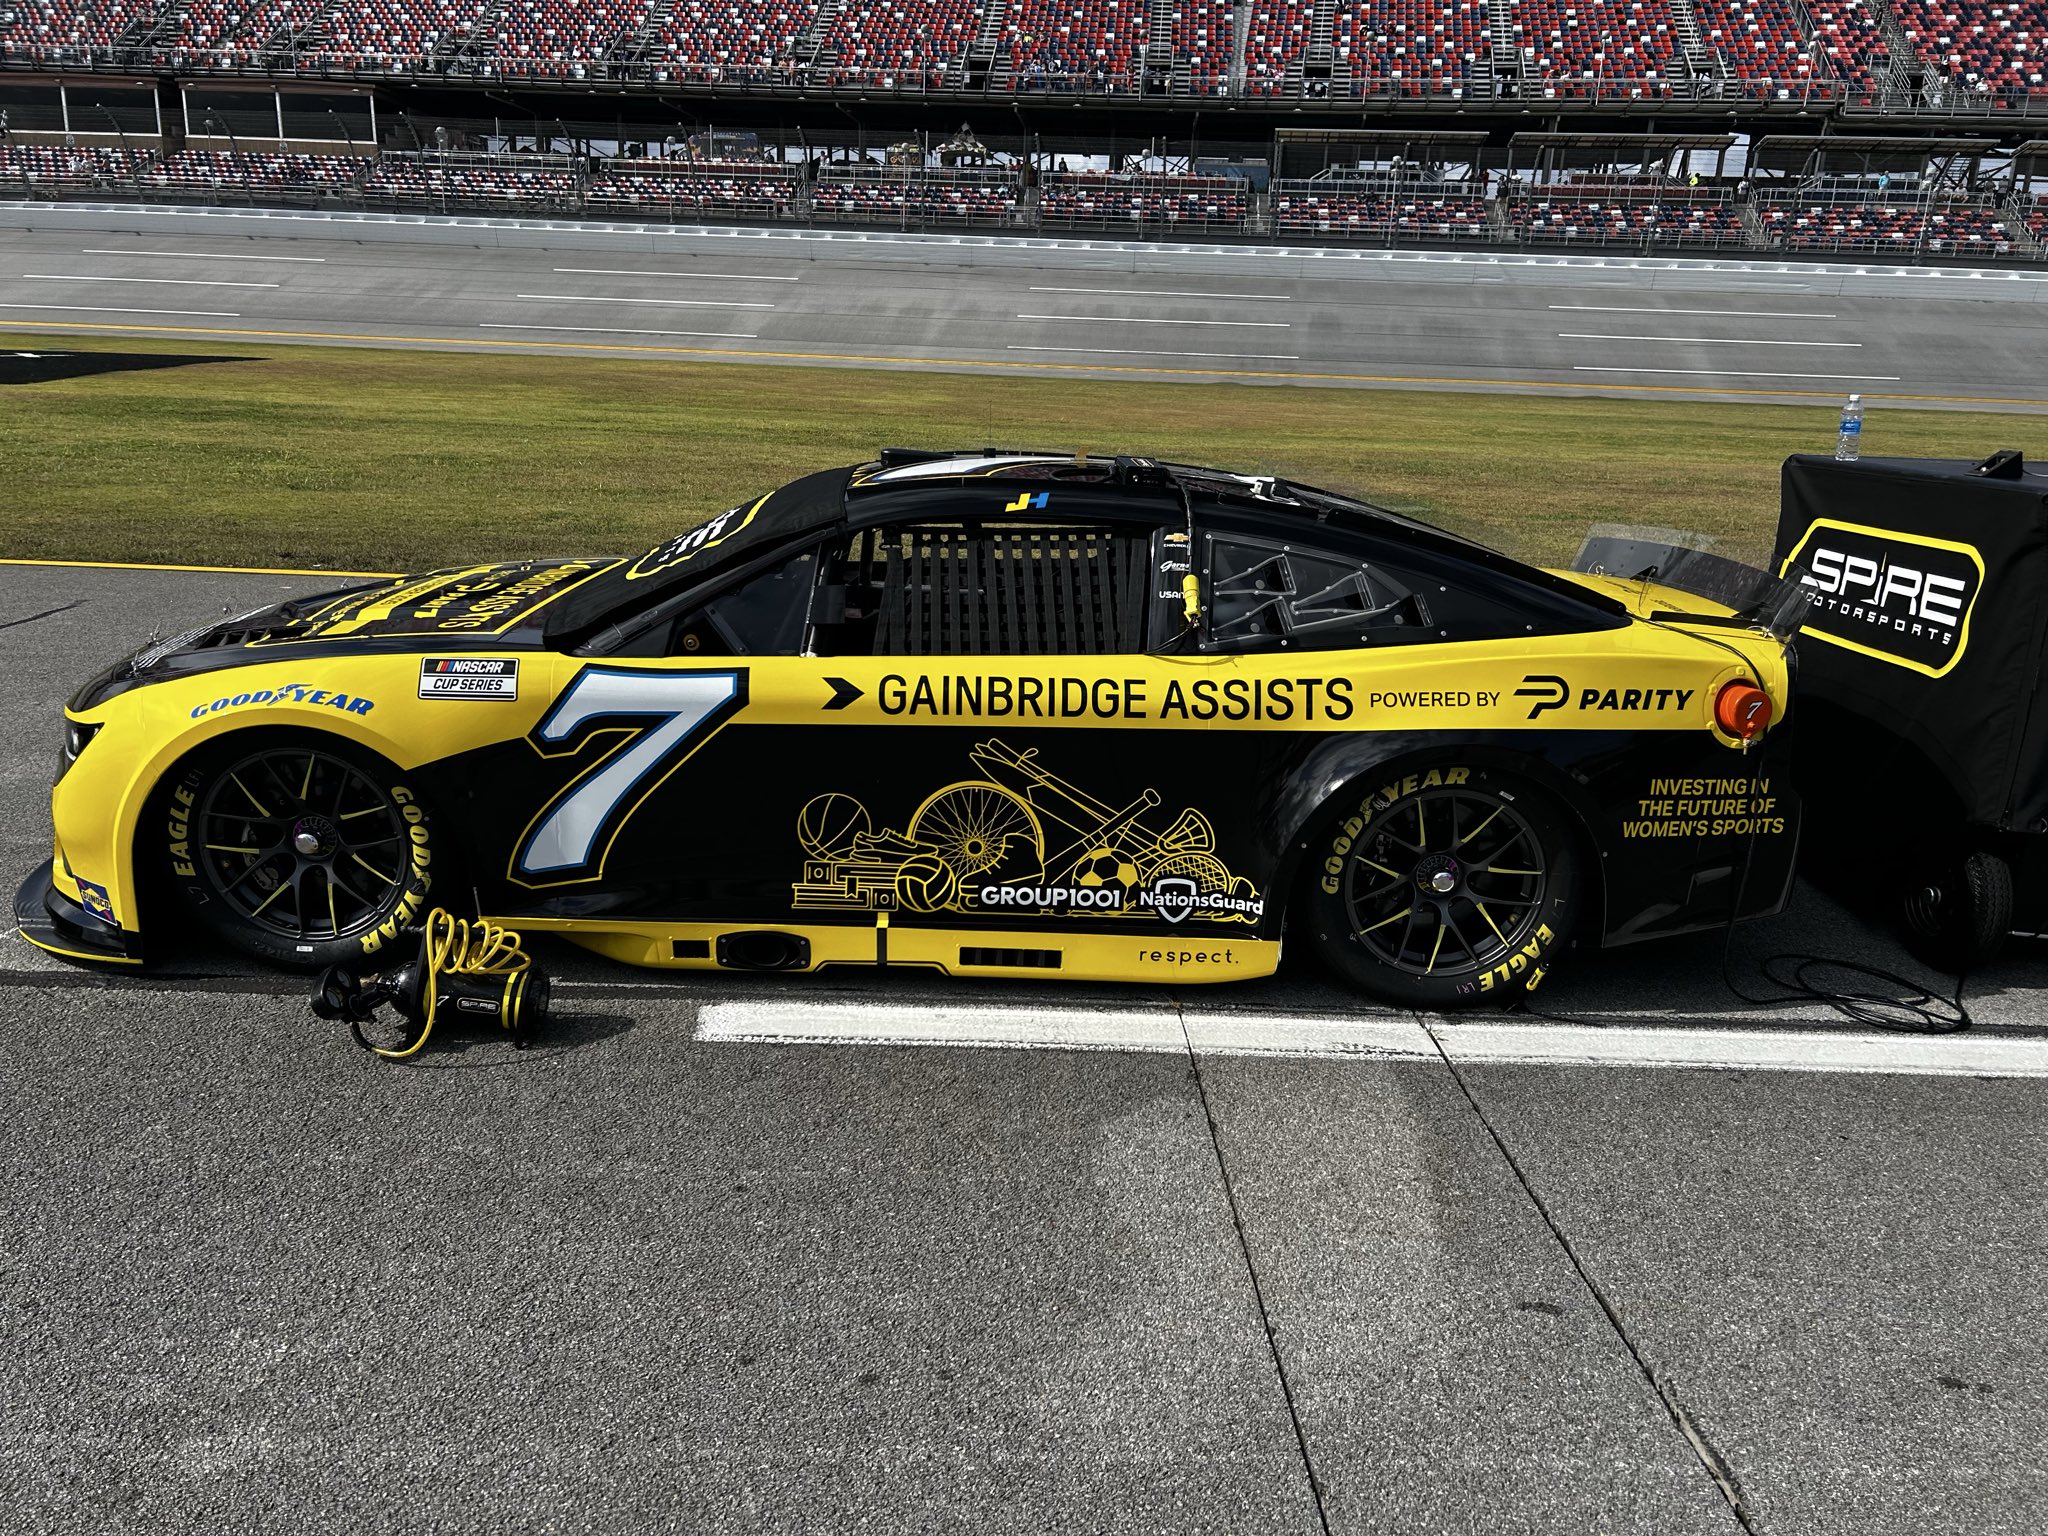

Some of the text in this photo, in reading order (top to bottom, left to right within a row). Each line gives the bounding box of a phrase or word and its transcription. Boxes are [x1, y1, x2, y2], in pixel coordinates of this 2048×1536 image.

[1159, 590, 1185, 599] USAN
[1800, 547, 1966, 628] SPIRE
[1804, 590, 1952, 645] OTORSPORTS
[452, 660, 504, 674] NASCAR
[433, 677, 504, 691] CUP SERIES
[877, 674, 1354, 722] GAINBRIDGE ASSISTS
[1370, 691, 1501, 708] POWERED BY
[1578, 688, 1695, 711] PARITY
[1746, 701, 1764, 720] 7
[520, 669, 738, 875] 7
[1650, 778, 1770, 796] INVESTING IN
[1638, 798, 1777, 817] THE FUTURE OF
[168, 784, 197, 877] EAGLE
[1623, 817, 1785, 838] WOMEN'S SPORTS
[82, 890, 110, 909] SUNOCO
[981, 886, 1120, 908] GROUP1001
[1139, 949, 1240, 965] respect.
[1479, 922, 1556, 993] EAGLE
